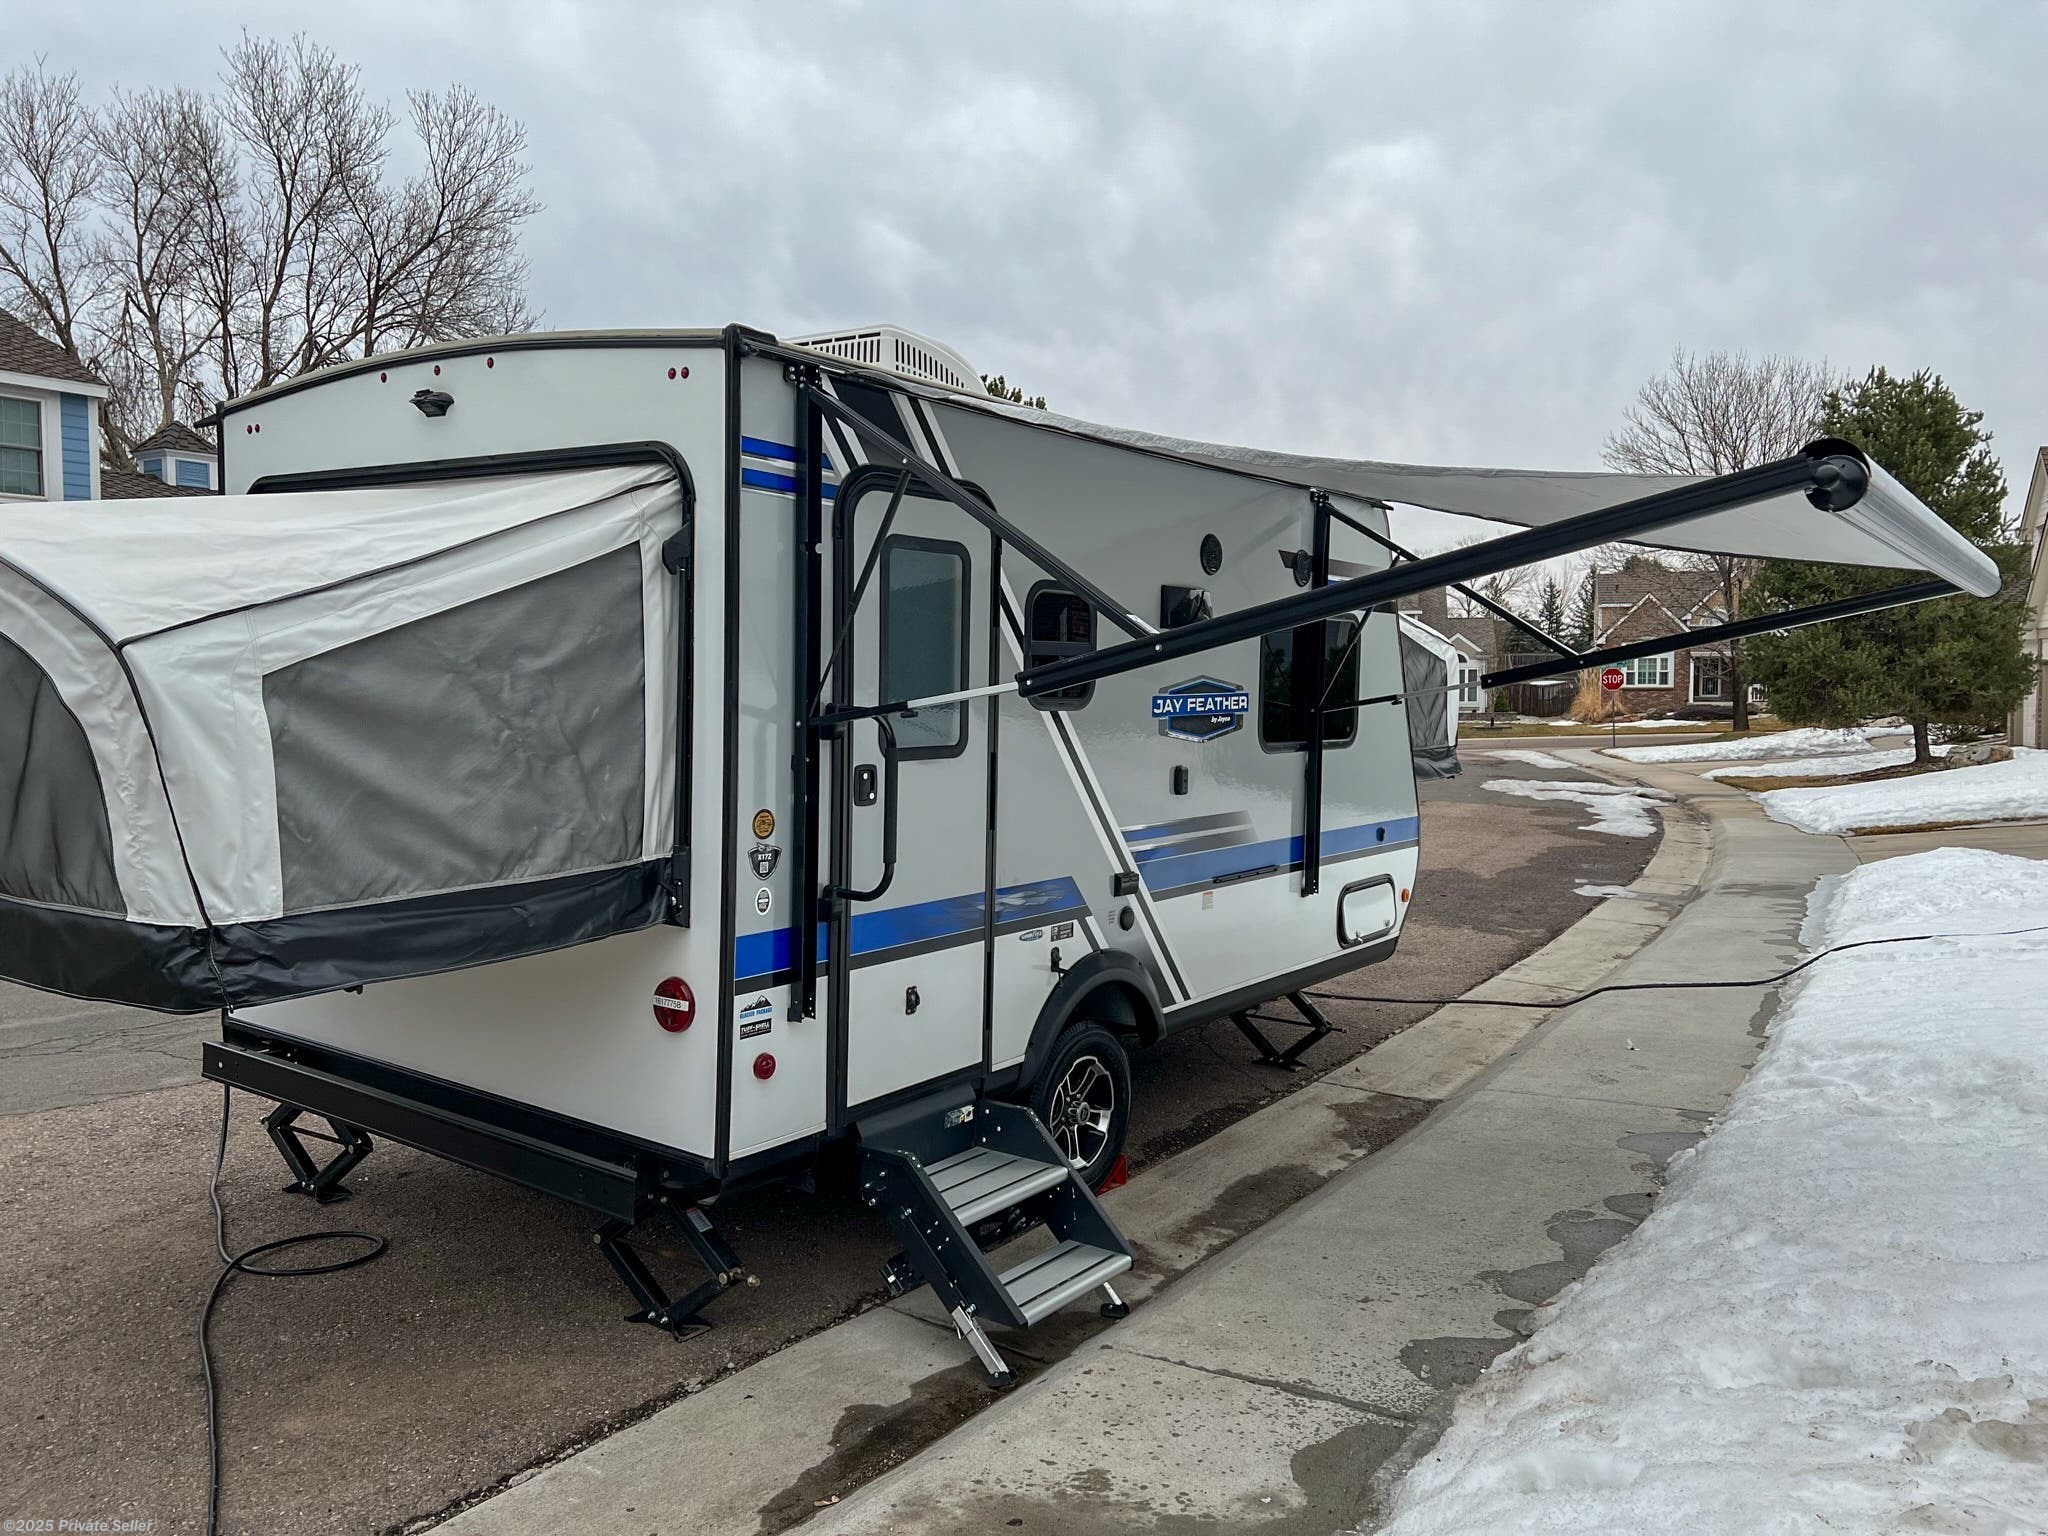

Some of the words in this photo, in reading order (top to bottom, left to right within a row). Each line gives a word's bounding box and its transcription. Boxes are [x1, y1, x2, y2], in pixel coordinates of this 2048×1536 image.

[1602, 674, 1623, 685] STOP
[1153, 698, 1183, 714] JAY
[1187, 695, 1248, 712] FEATHER
[1210, 716, 1218, 724] by
[1217, 715, 1231, 723] Jayco
[757, 853, 772, 861] X17Z
[756, 1007, 772, 1015] PACKAGE
